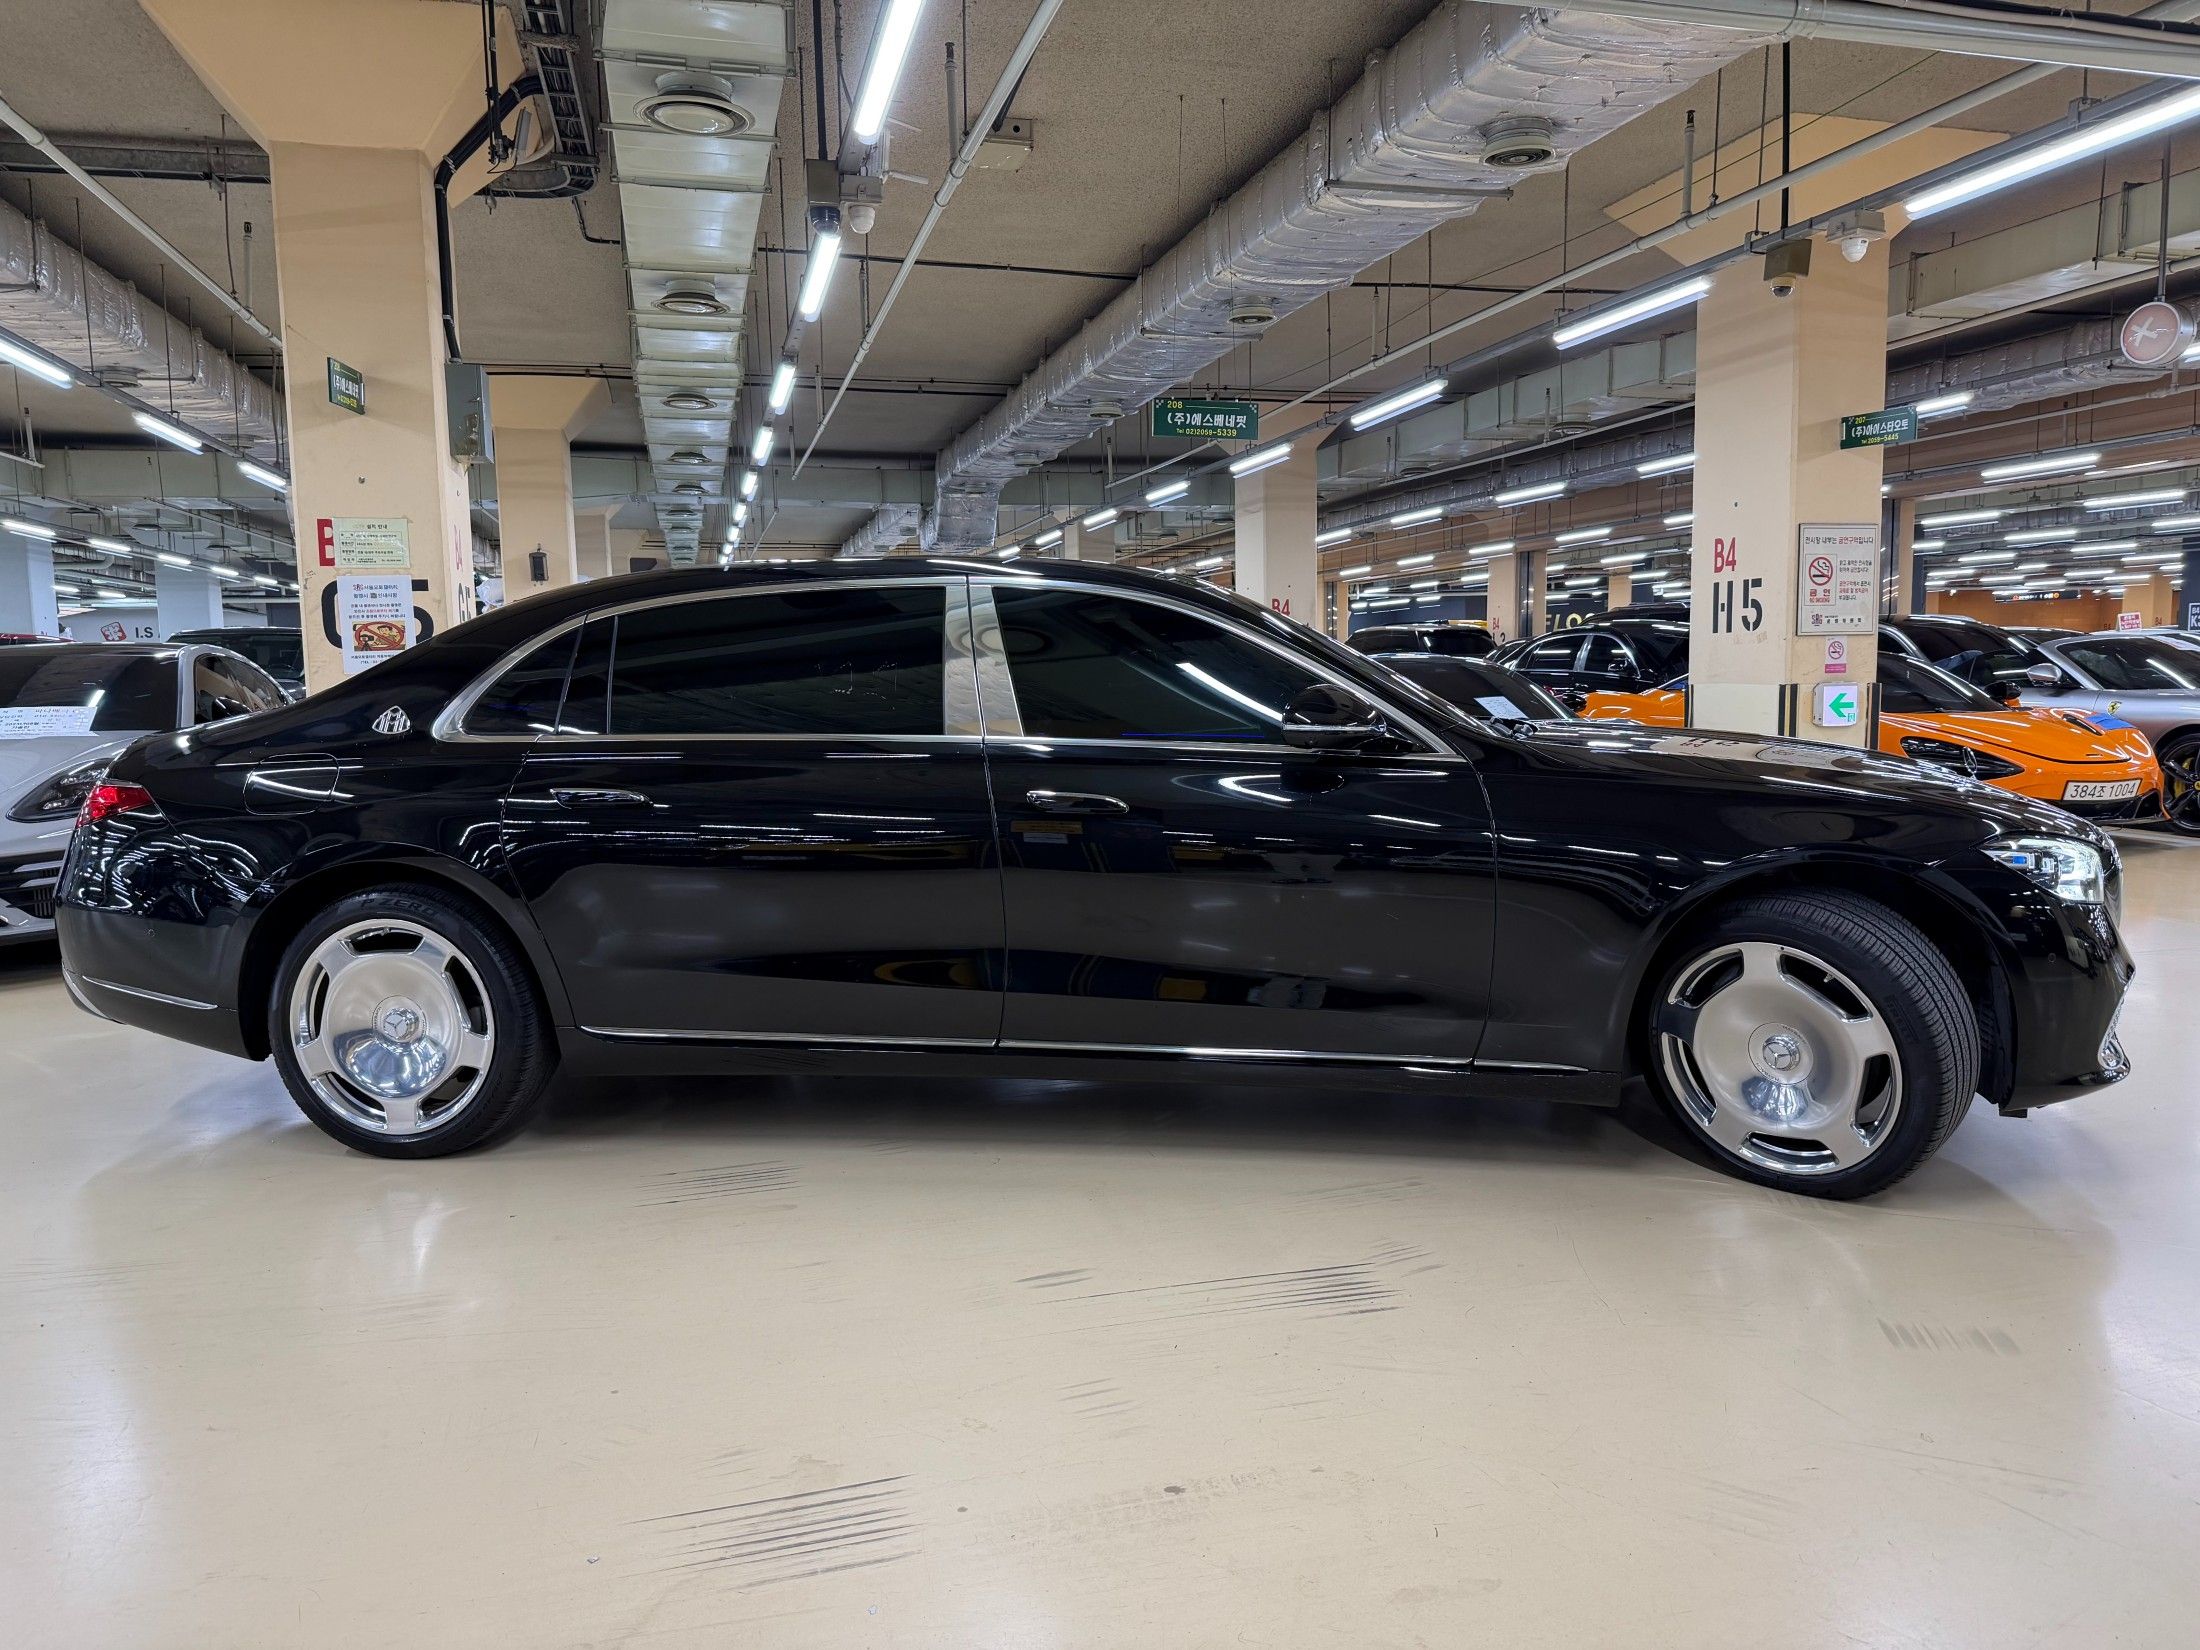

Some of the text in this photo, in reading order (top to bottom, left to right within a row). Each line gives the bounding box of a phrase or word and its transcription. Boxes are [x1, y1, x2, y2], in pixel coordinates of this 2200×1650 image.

[1167, 400, 1183, 409] 208
[1167, 412, 1247, 428] (주)에스베네핏
[1855, 416, 1866, 424] 207
[1713, 537, 1737, 574] B4
[1712, 578, 1763, 634] H5
[2070, 782, 2136, 799] 384조 1004
